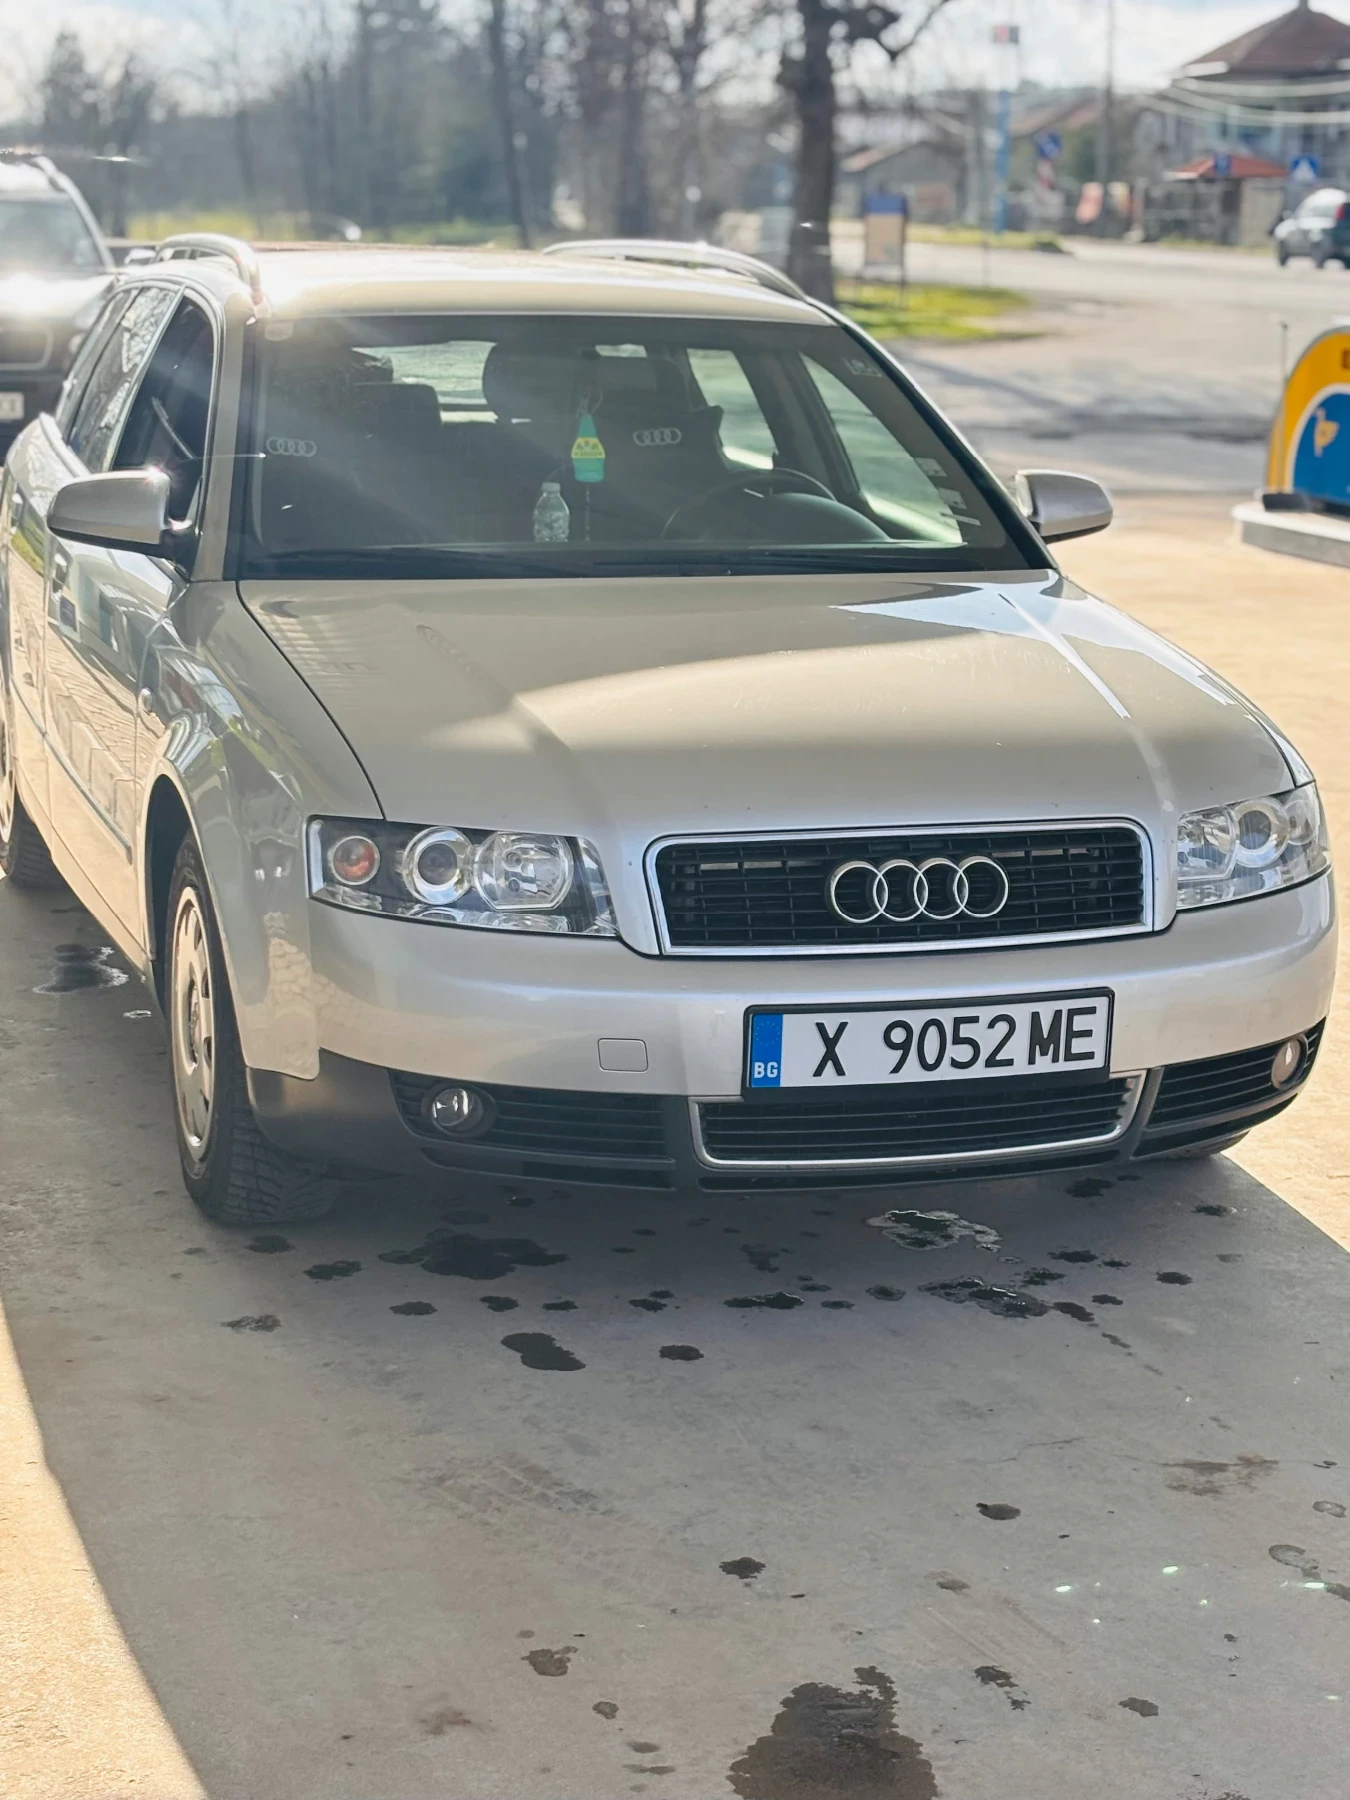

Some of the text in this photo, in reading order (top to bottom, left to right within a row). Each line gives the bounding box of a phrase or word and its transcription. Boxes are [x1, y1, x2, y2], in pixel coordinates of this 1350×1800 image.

[812, 1006, 1097, 1077] X 9052 ME
[754, 1061, 778, 1078] BG
